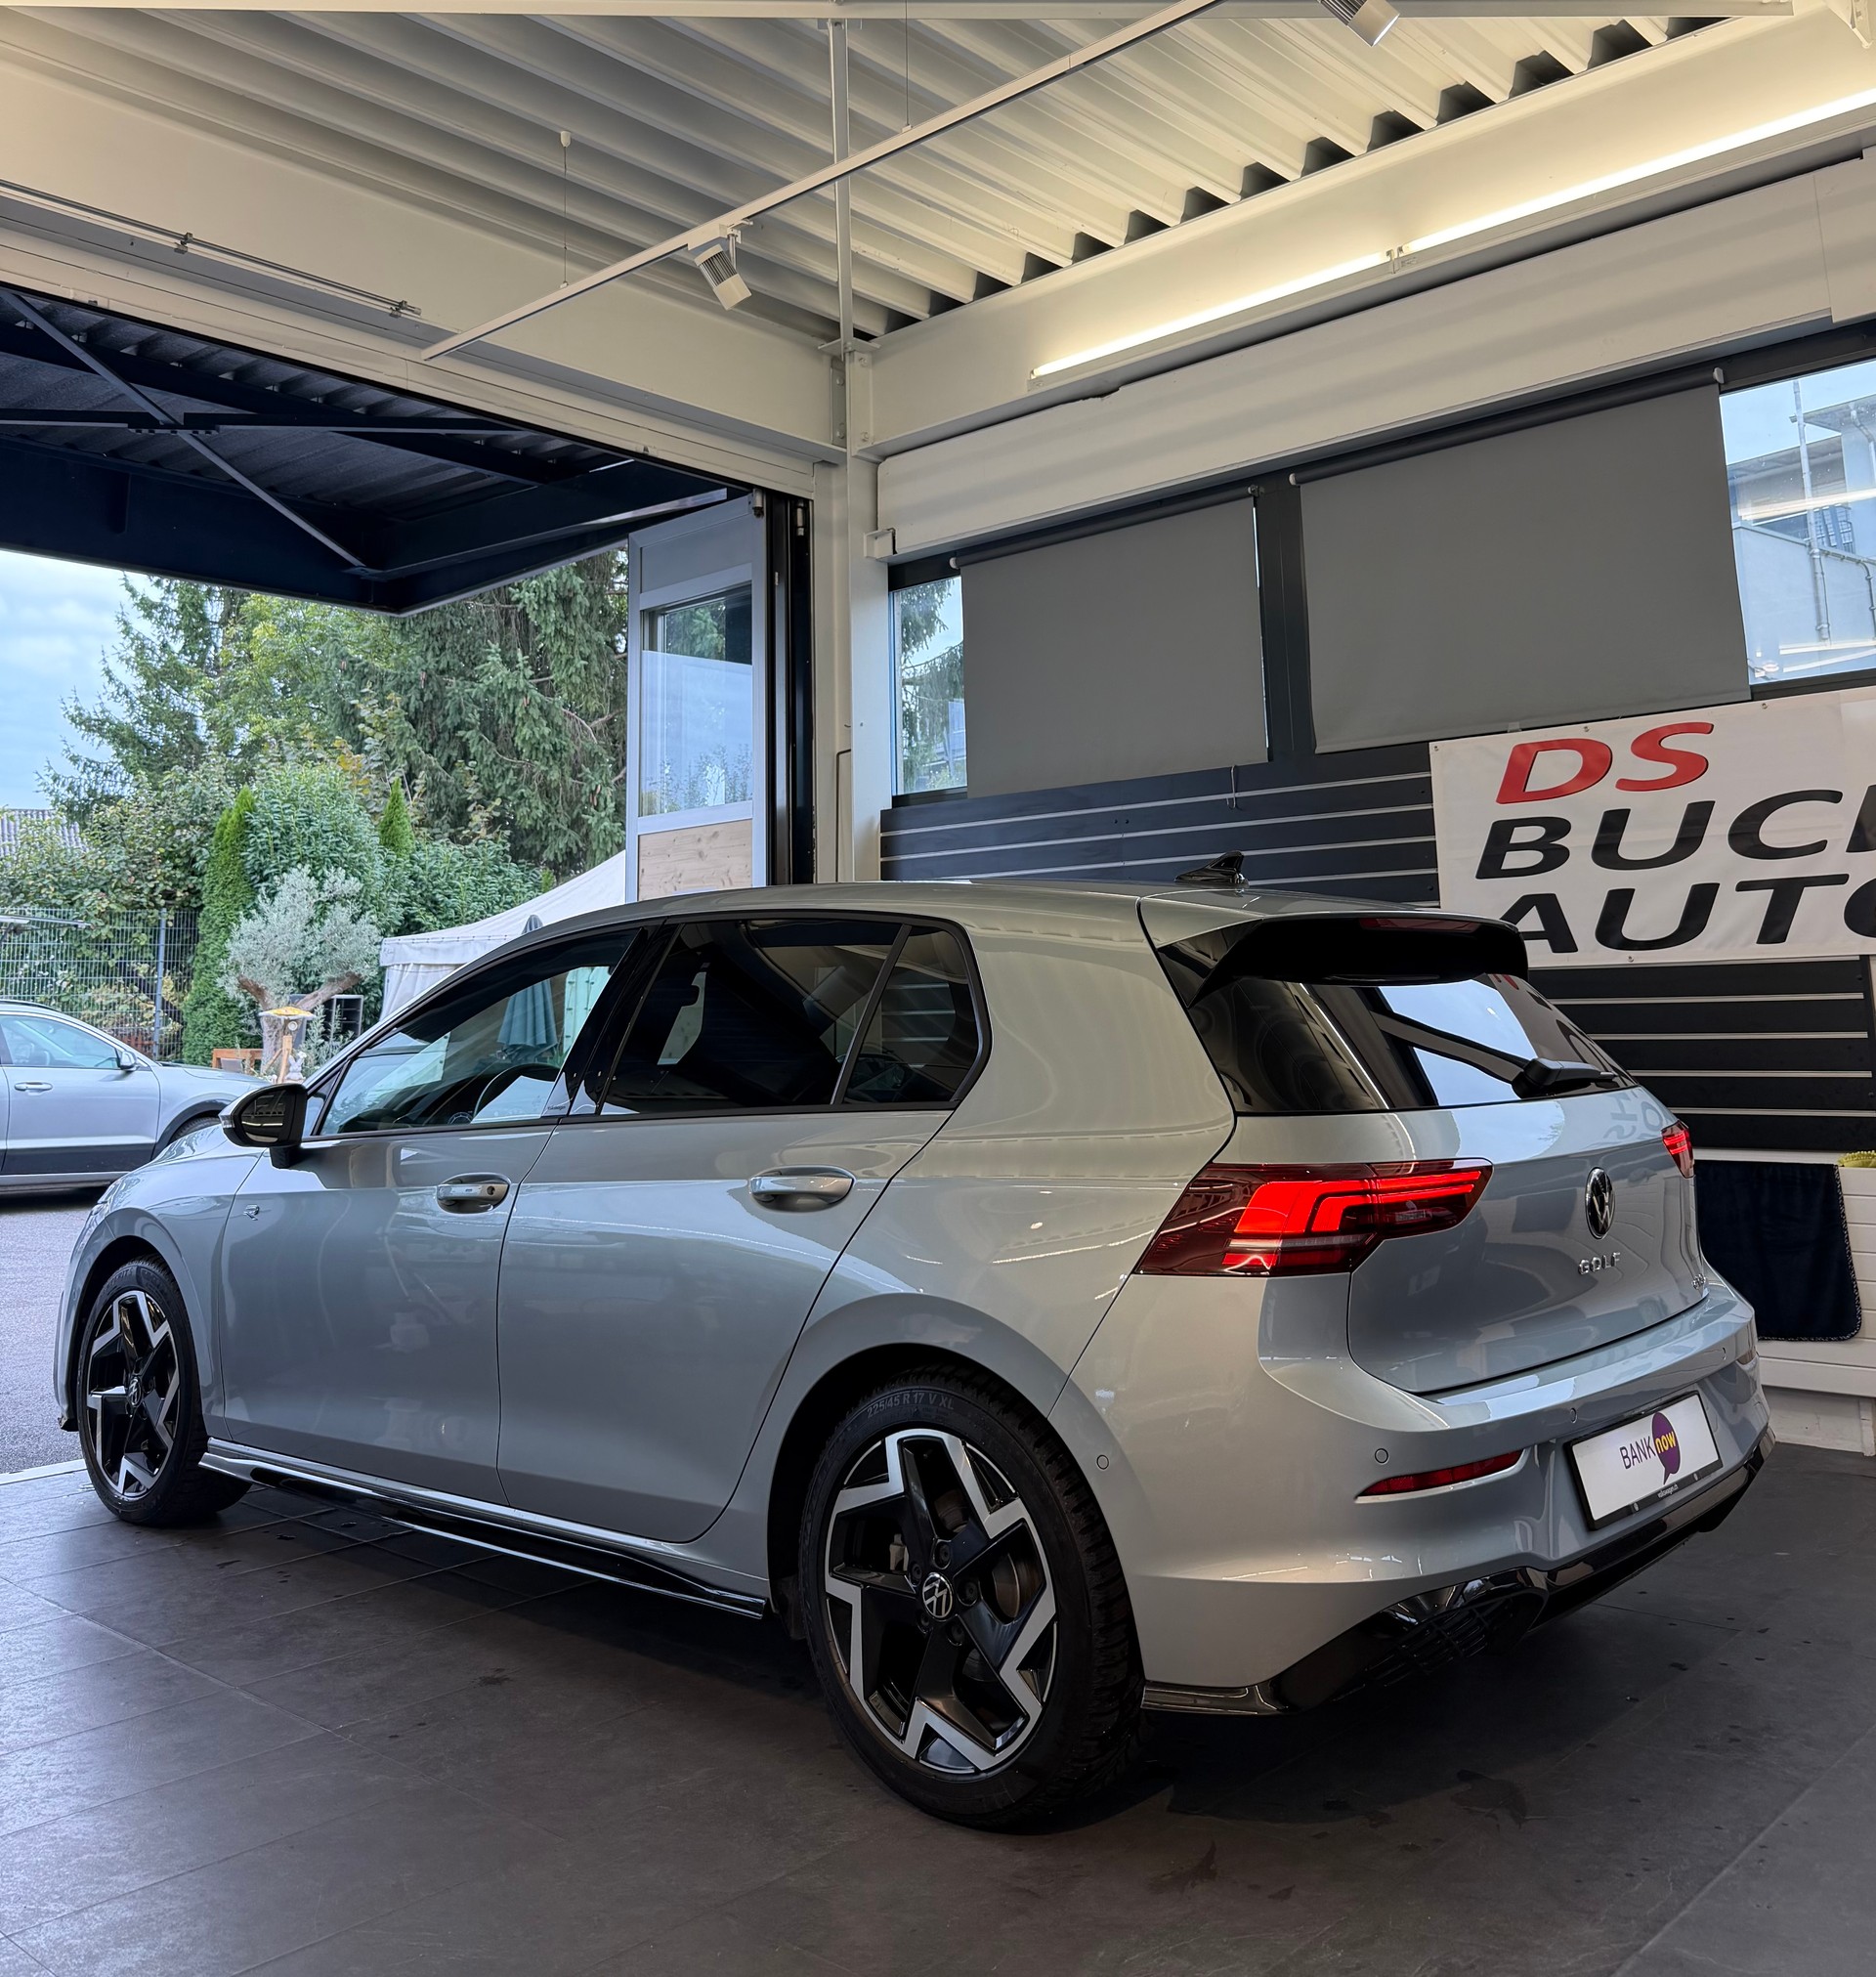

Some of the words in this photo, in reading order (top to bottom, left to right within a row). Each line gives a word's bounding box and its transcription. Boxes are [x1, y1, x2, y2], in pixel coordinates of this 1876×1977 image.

[1495, 721, 1715, 804] DS
[1578, 1252, 1621, 1275] GOLF
[867, 1395, 900, 1418] 225/45
[903, 1393, 911, 1404] R
[914, 1393, 925, 1404] 17
[928, 1393, 937, 1404] V
[939, 1395, 954, 1410] XL
[1619, 1436, 1656, 1470] BANK
[1654, 1431, 1677, 1454] now
